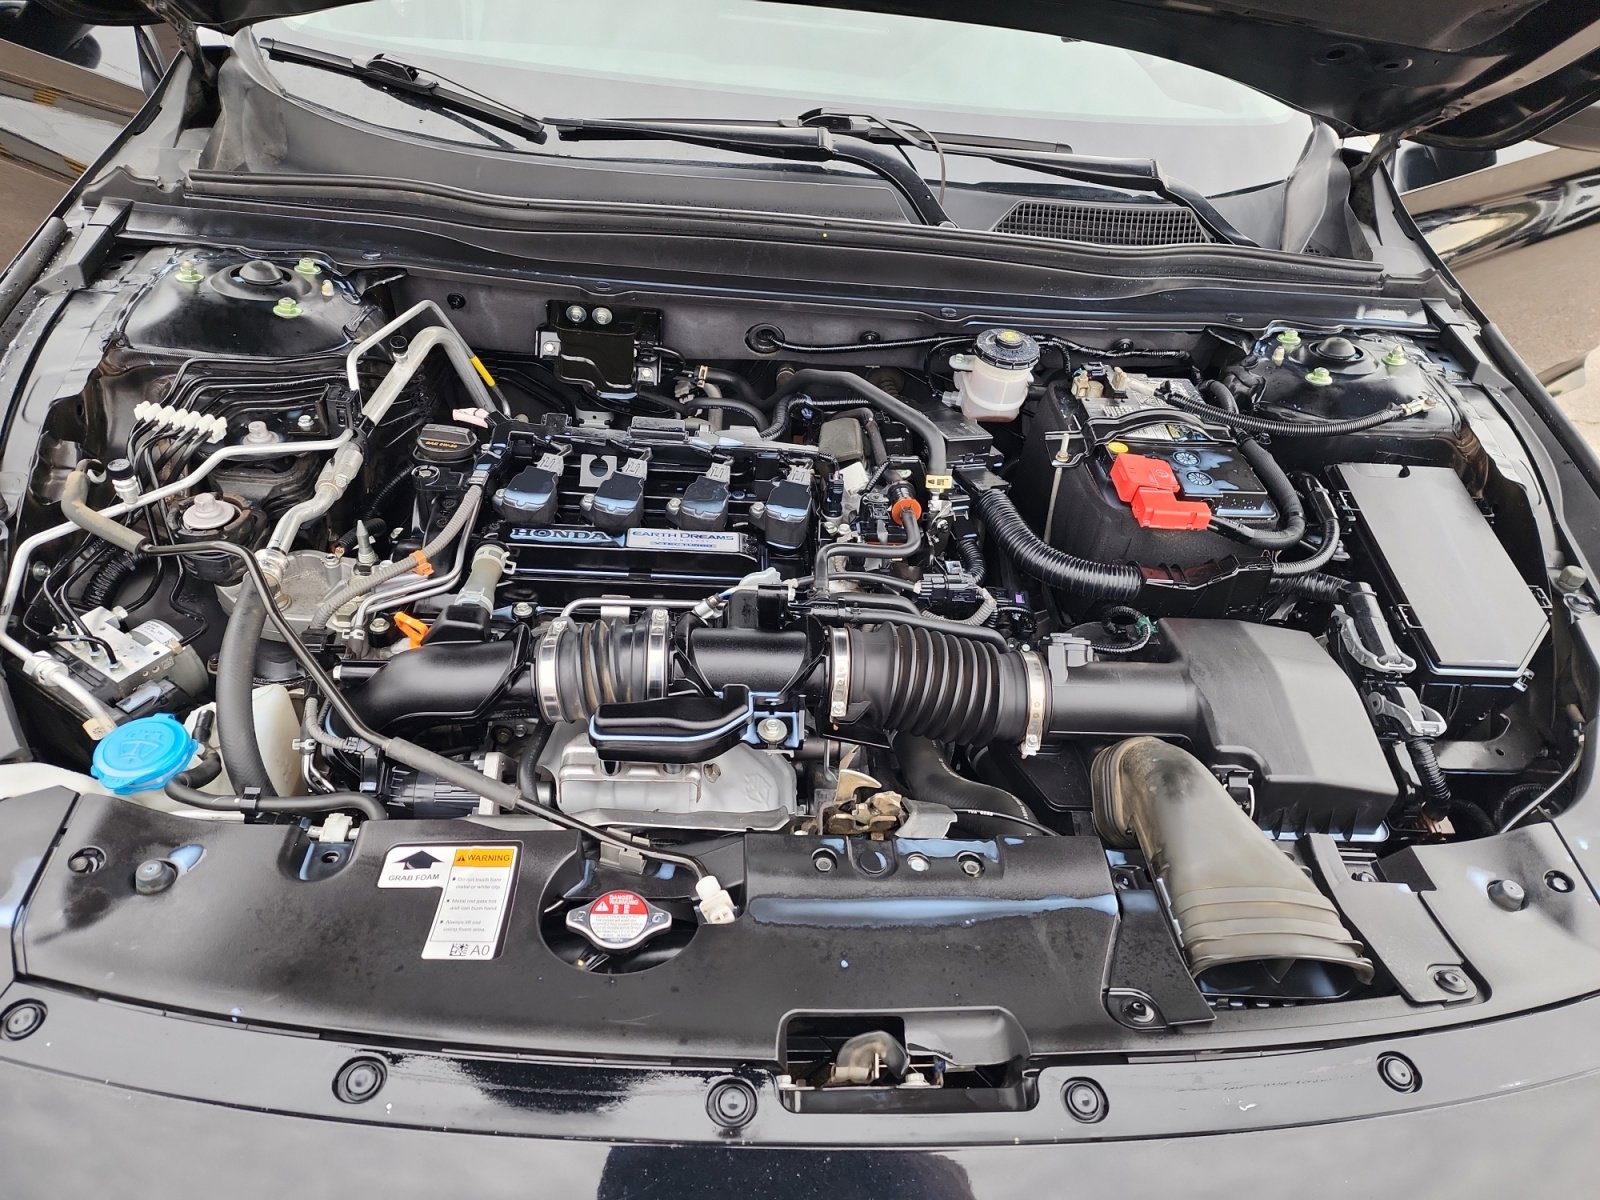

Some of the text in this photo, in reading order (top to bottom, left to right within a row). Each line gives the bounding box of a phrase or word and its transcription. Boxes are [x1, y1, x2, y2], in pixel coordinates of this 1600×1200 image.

[512, 528, 610, 541] HONDA
[632, 530, 734, 541] EARTH DREAMS
[468, 854, 510, 862] WARNING
[415, 873, 440, 881] FOAM
[470, 944, 490, 956] A0
